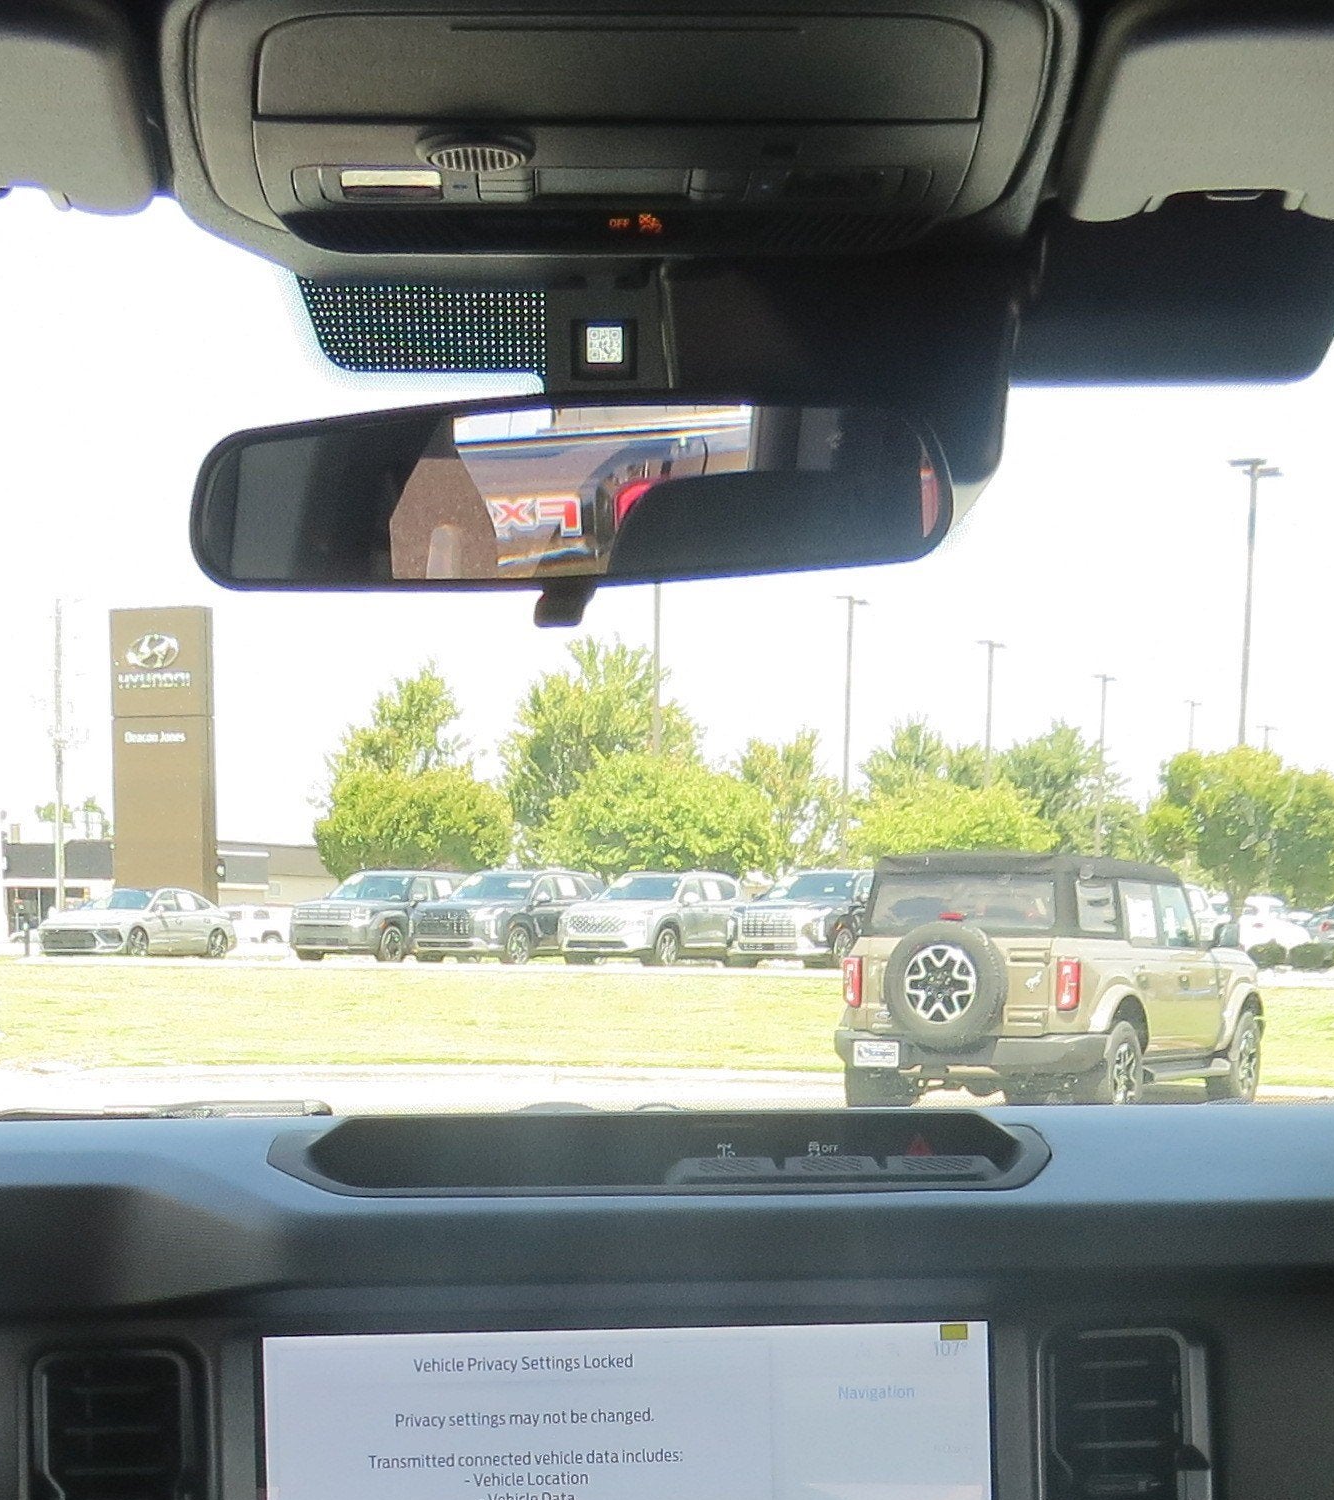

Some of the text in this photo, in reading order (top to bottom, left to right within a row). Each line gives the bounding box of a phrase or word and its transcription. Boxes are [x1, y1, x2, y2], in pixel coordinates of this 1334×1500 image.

[609, 217, 630, 229] OFF
[117, 671, 191, 690] HYUNDAI
[160, 730, 186, 743] Jones
[821, 1144, 839, 1153] OFF
[414, 1354, 633, 1374] Vehicle Privacy Settings Locked
[838, 1384, 915, 1401] Navigation
[395, 1408, 654, 1430] Privacy settings may not be changed.
[368, 1448, 683, 1469] Transmitted connected vehicle data includes:
[473, 1471, 588, 1487] Vehicle Location
